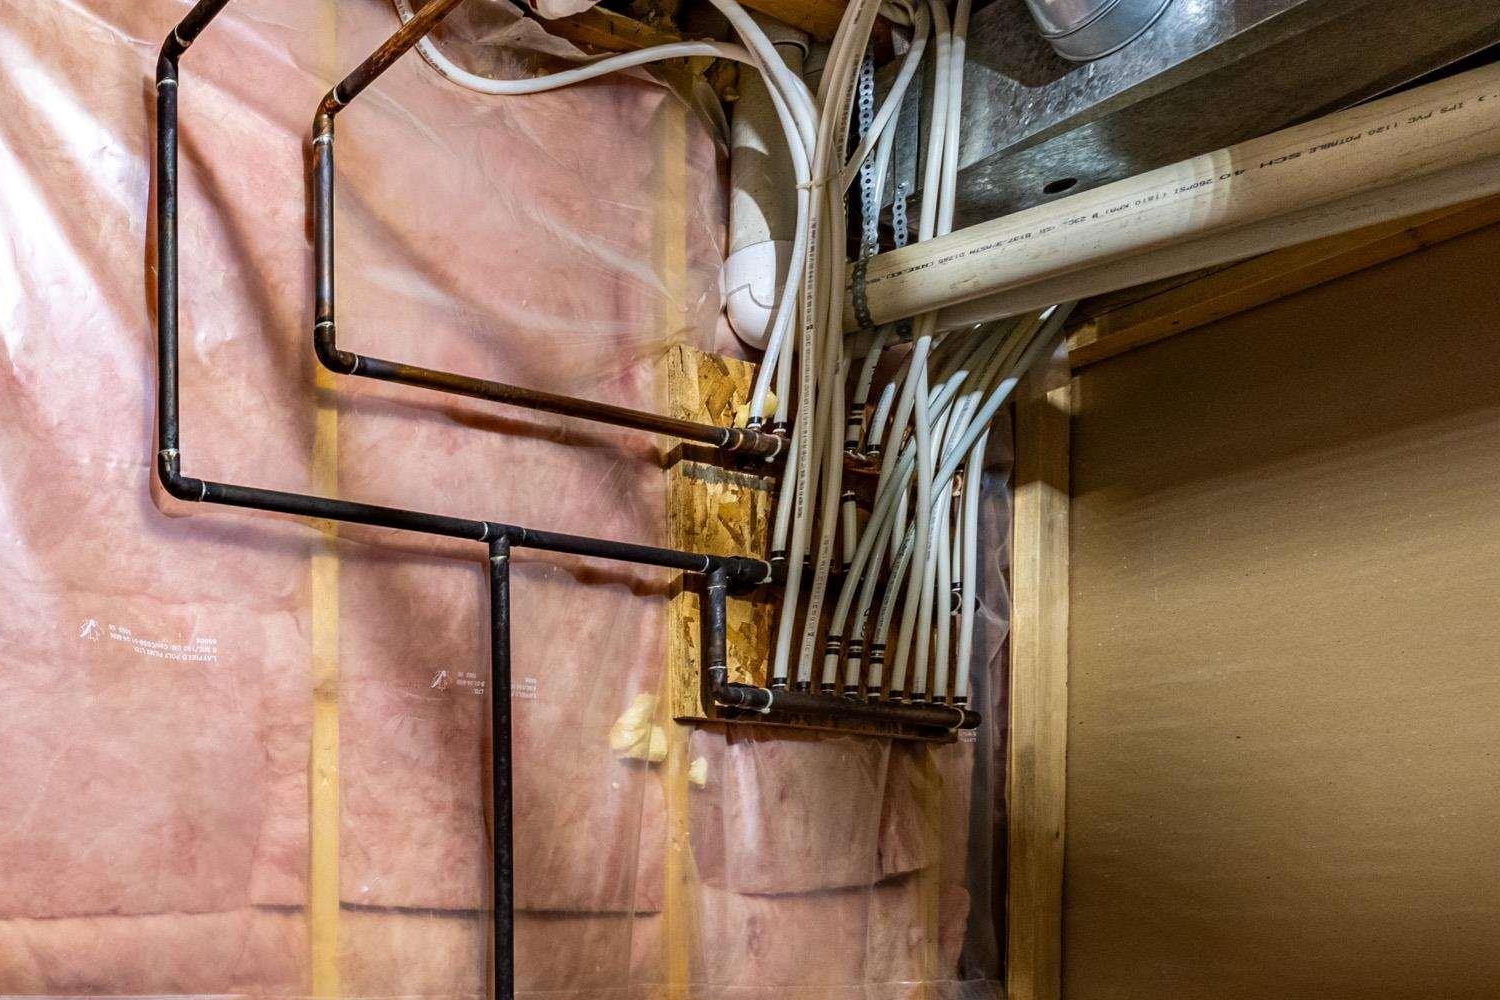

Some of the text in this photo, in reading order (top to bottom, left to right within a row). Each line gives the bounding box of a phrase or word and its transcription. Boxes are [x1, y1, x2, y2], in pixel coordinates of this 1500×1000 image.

[1406, 112, 1433, 125] PVC
[1308, 133, 1363, 153] POTABLE
[1258, 151, 1302, 168] SCH
[1219, 168, 1246, 180] 40
